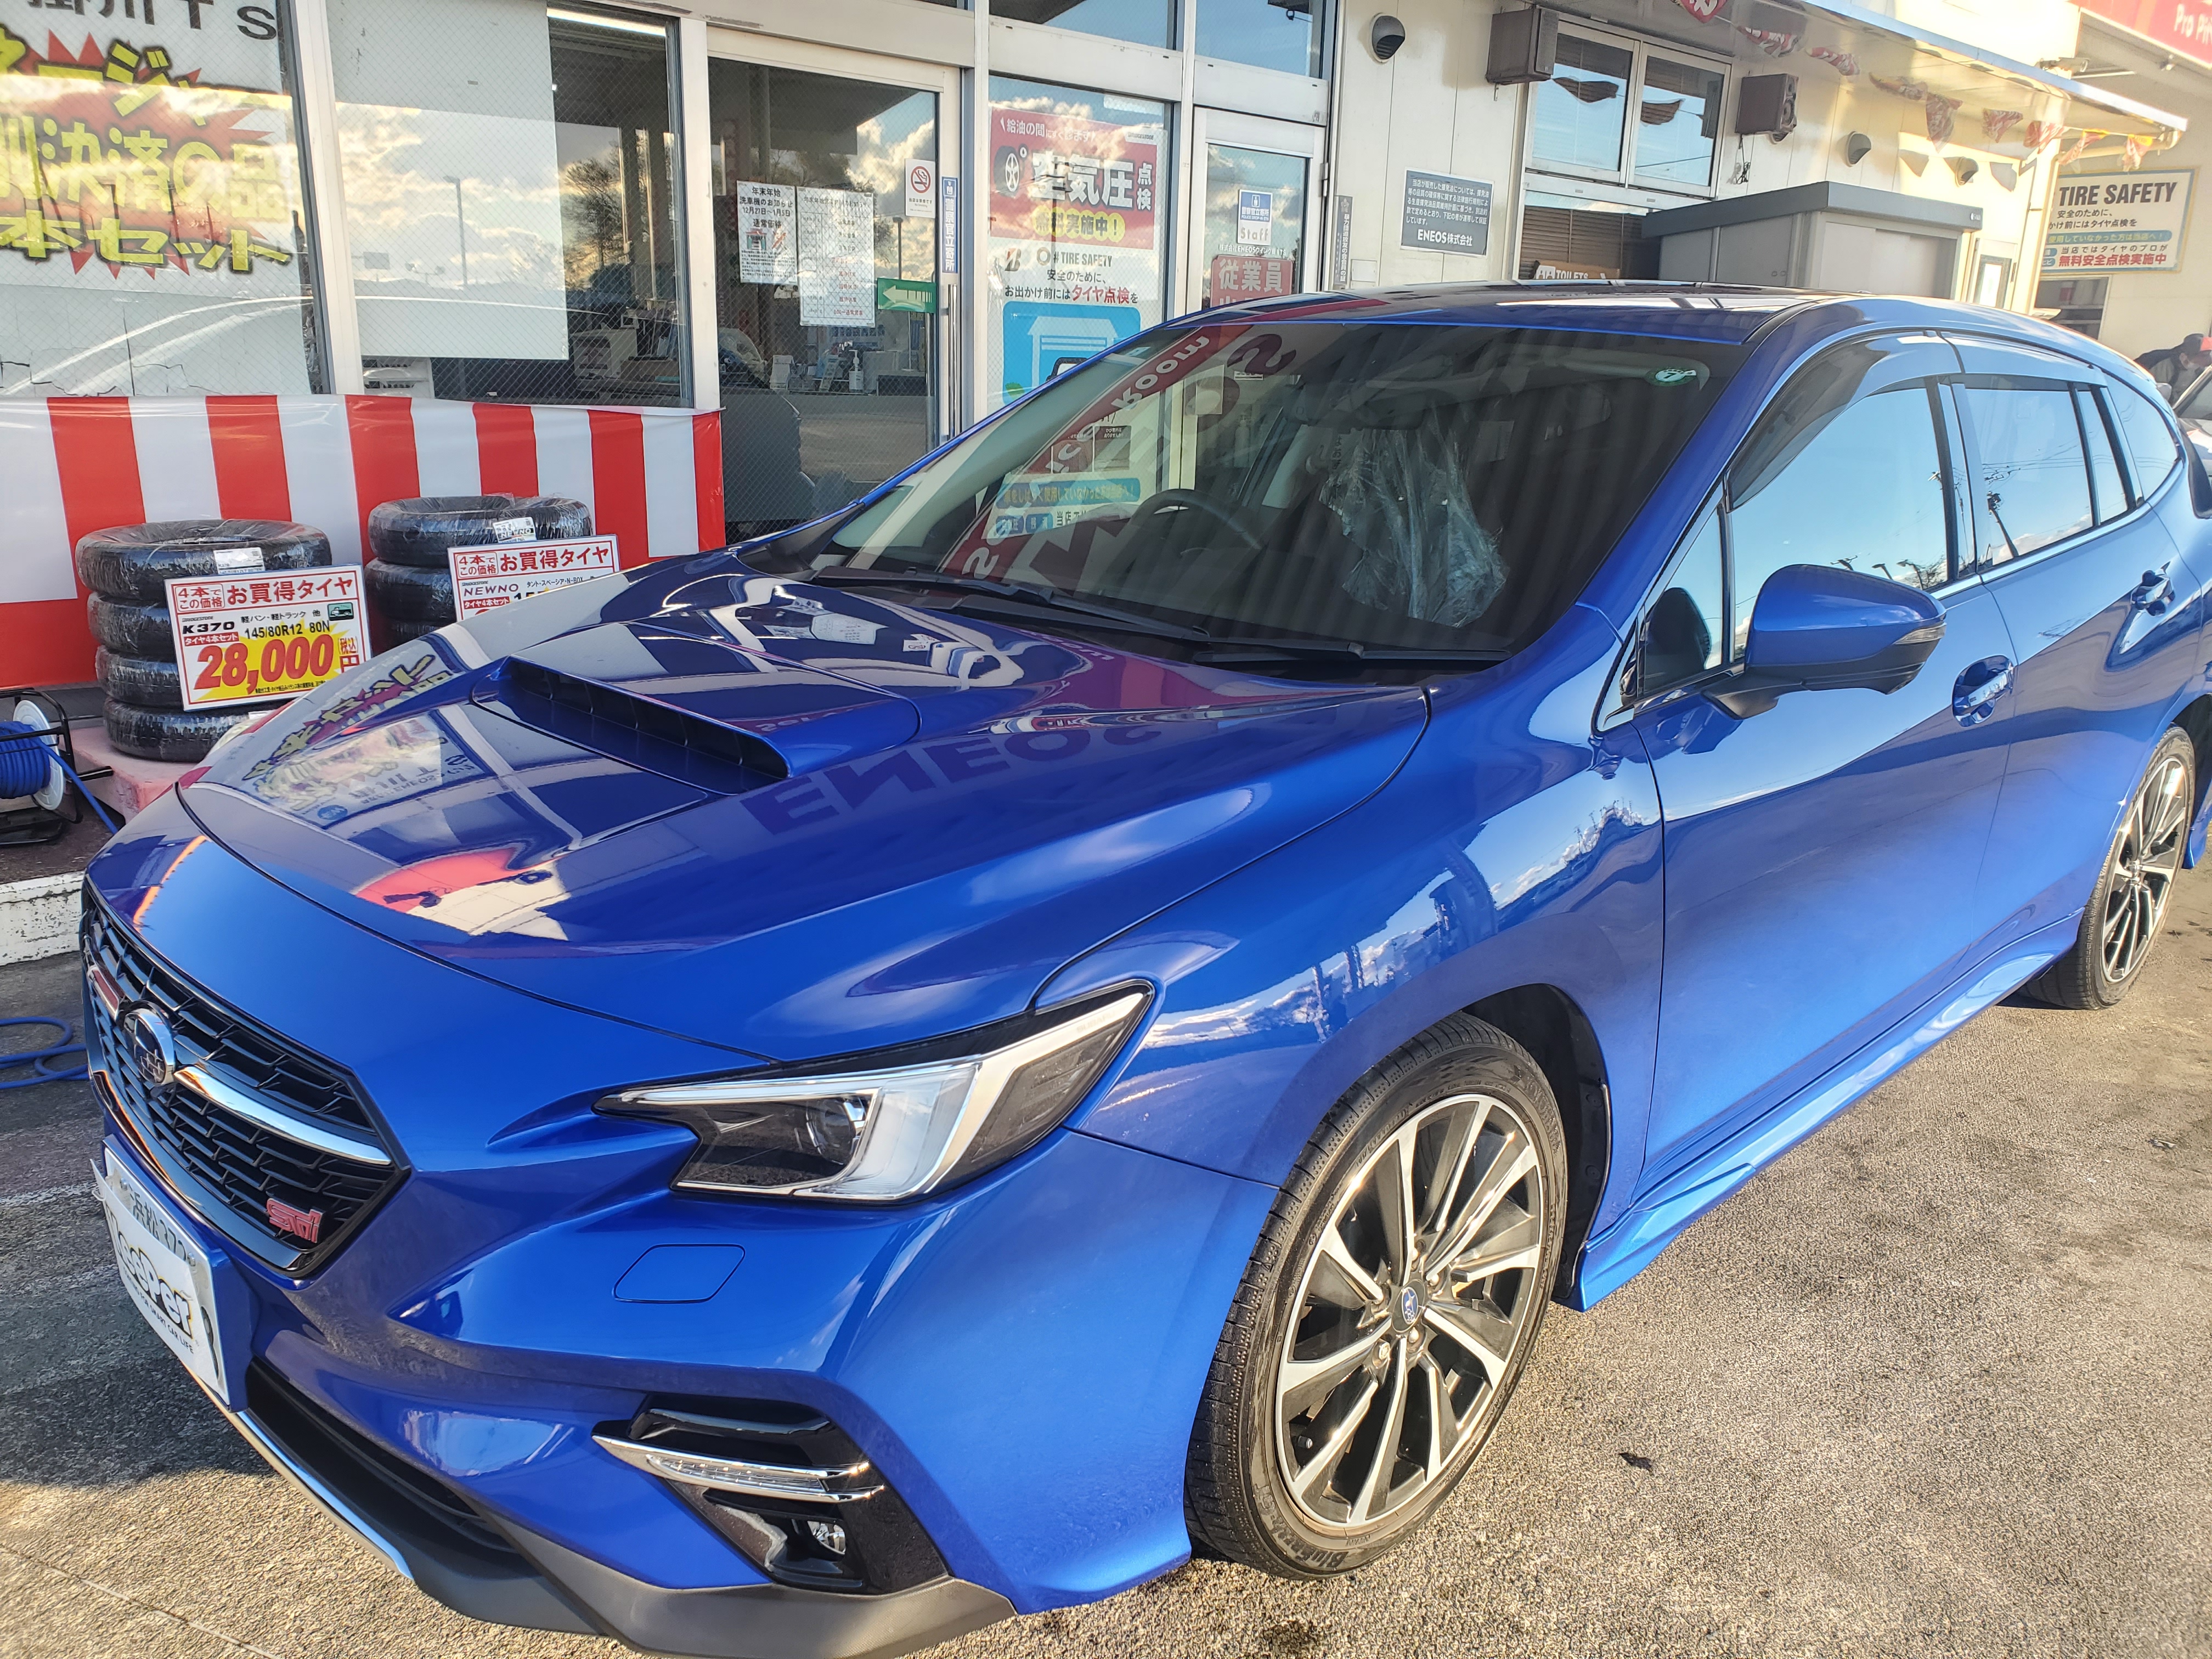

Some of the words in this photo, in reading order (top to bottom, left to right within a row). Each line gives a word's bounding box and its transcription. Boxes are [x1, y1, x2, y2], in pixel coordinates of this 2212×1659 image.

[752, 187, 781, 197] 年末年始
[2059, 185, 2100, 206] TIRE
[2103, 182, 2177, 205] SAFETY
[945, 198, 955, 272] 警察官立寄所
[1240, 227, 1268, 241] Staff
[1218, 258, 1283, 294] 従業員
[500, 546, 609, 572] お買得タイヤ
[460, 564, 496, 575] この価格
[178, 586, 222, 599] 4本で
[227, 576, 353, 605] お買得タイヤ
[464, 583, 519, 597] NEWNO
[179, 596, 223, 610] この価格
[464, 596, 510, 610] タイヤ4本セット
[182, 621, 235, 635] K370
[245, 623, 303, 640] 145/80R12
[309, 620, 330, 634] 80N
[184, 633, 238, 645] タイヤ4本セット
[194, 634, 334, 695] 28,000
[339, 654, 360, 674] 円
[167, 1324, 179, 1341] CAR
[180, 1335, 194, 1355] LIFE
